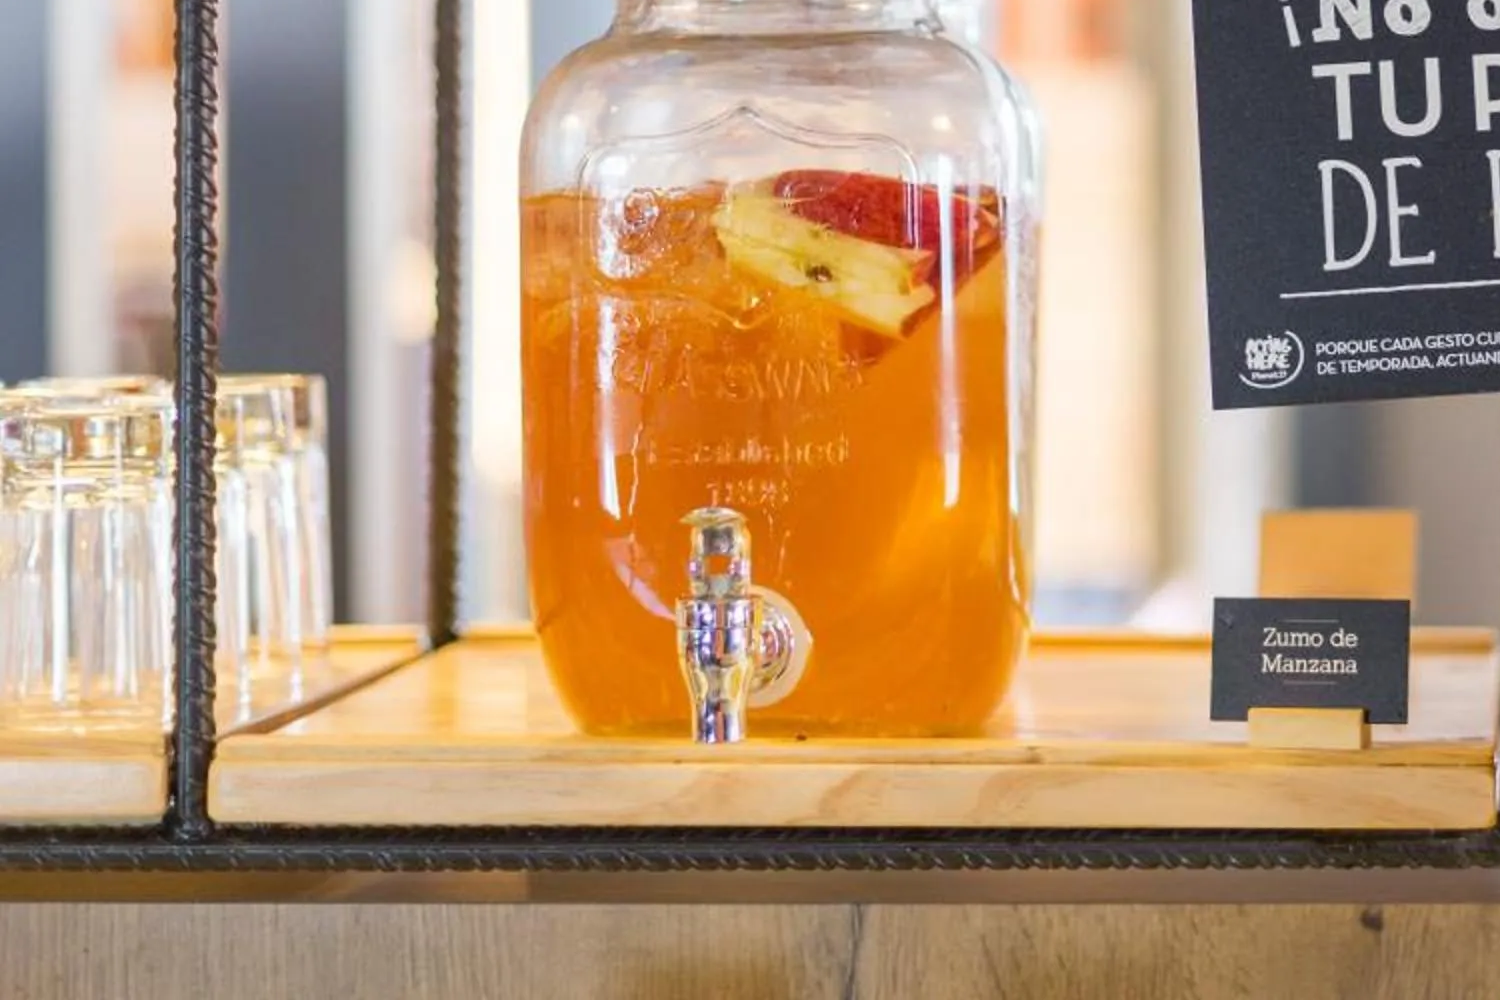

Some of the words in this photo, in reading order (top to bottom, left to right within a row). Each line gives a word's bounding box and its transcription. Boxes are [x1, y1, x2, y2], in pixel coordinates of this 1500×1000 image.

[1311, 56, 1443, 141] TU
[1318, 156, 1436, 271] DE
[1315, 338, 1378, 356] PORQUE
[1379, 336, 1423, 352] CADA
[1424, 333, 1475, 349] GESTO
[1316, 361, 1339, 375] DE
[1263, 627, 1324, 647] Zumo
[1330, 627, 1359, 648] de
[1261, 653, 1359, 675] Manzana
